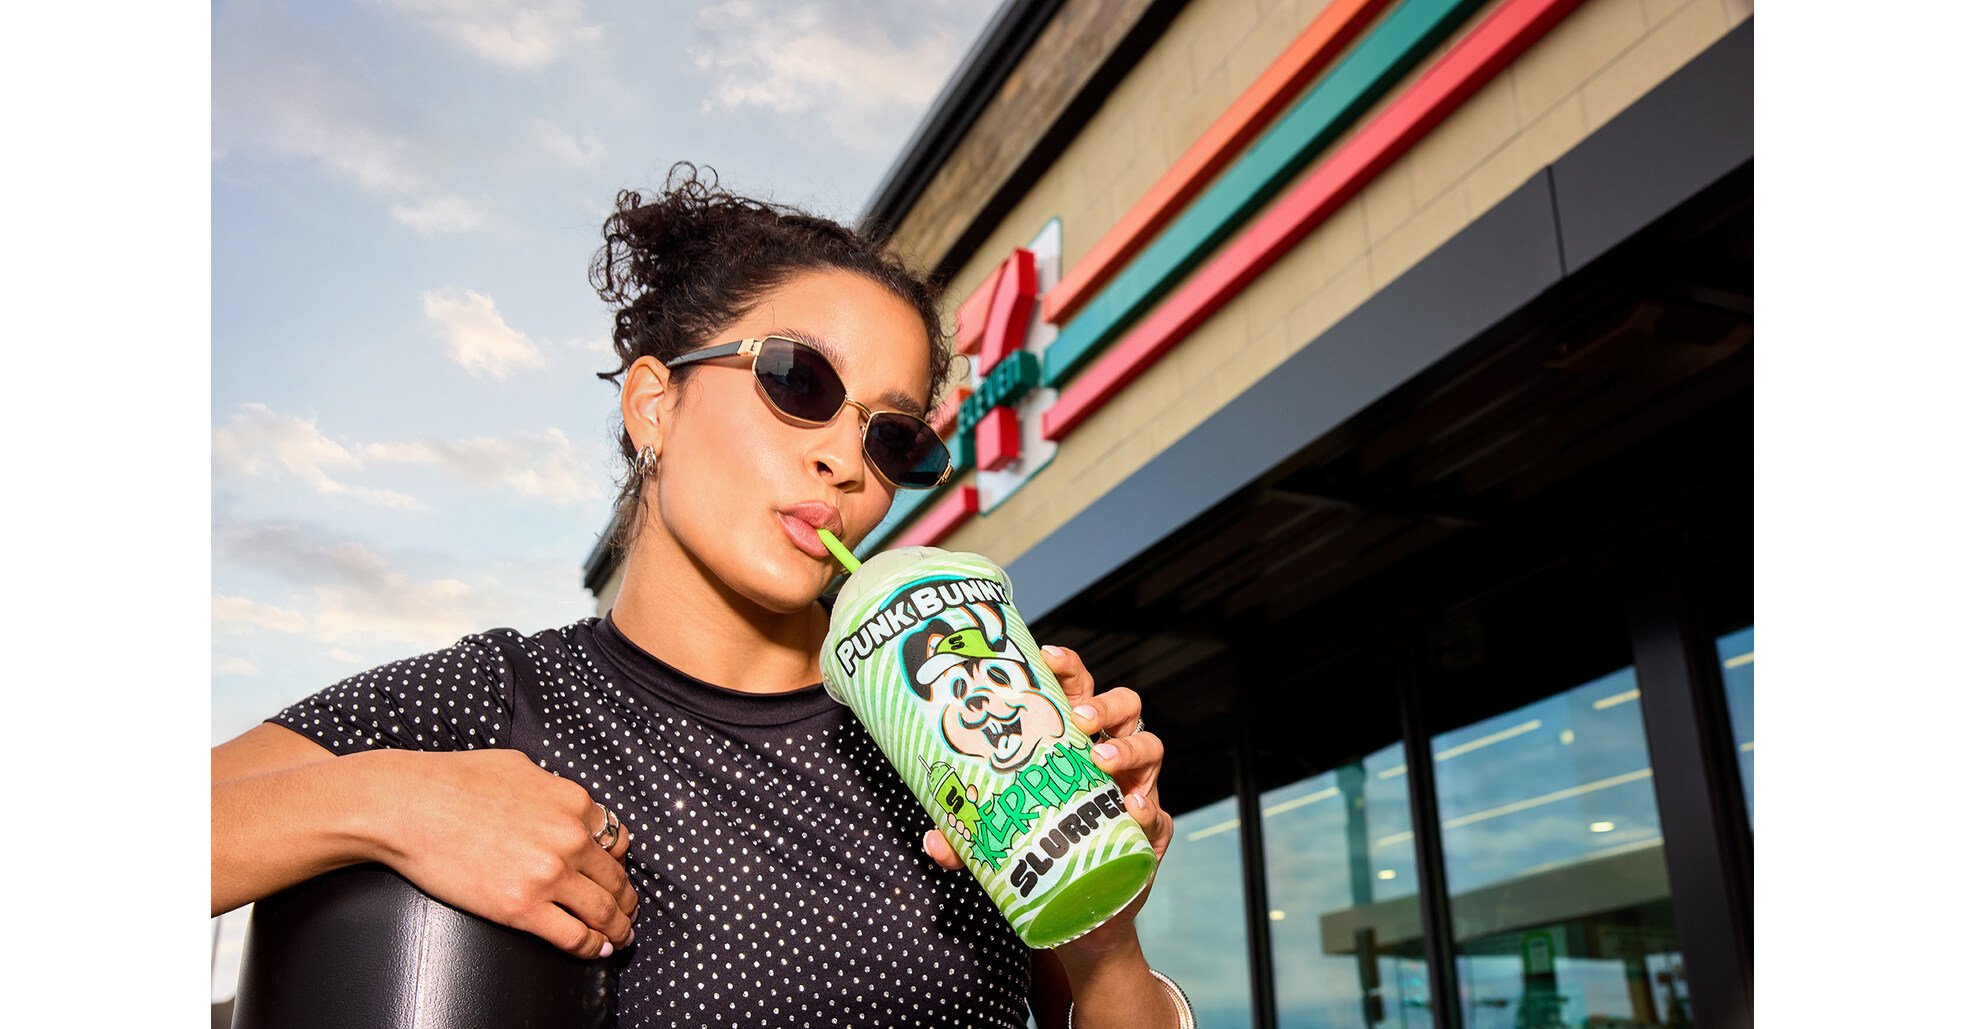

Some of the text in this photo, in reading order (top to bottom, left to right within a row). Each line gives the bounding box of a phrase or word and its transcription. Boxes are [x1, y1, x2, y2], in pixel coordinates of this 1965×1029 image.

[957, 248, 1036, 472] 7
[836, 578, 1010, 677] PUNK BUNNY
[945, 785, 965, 815] S
[972, 742, 1115, 871] KERPLUN
[1010, 788, 1127, 898] SLURPEE
